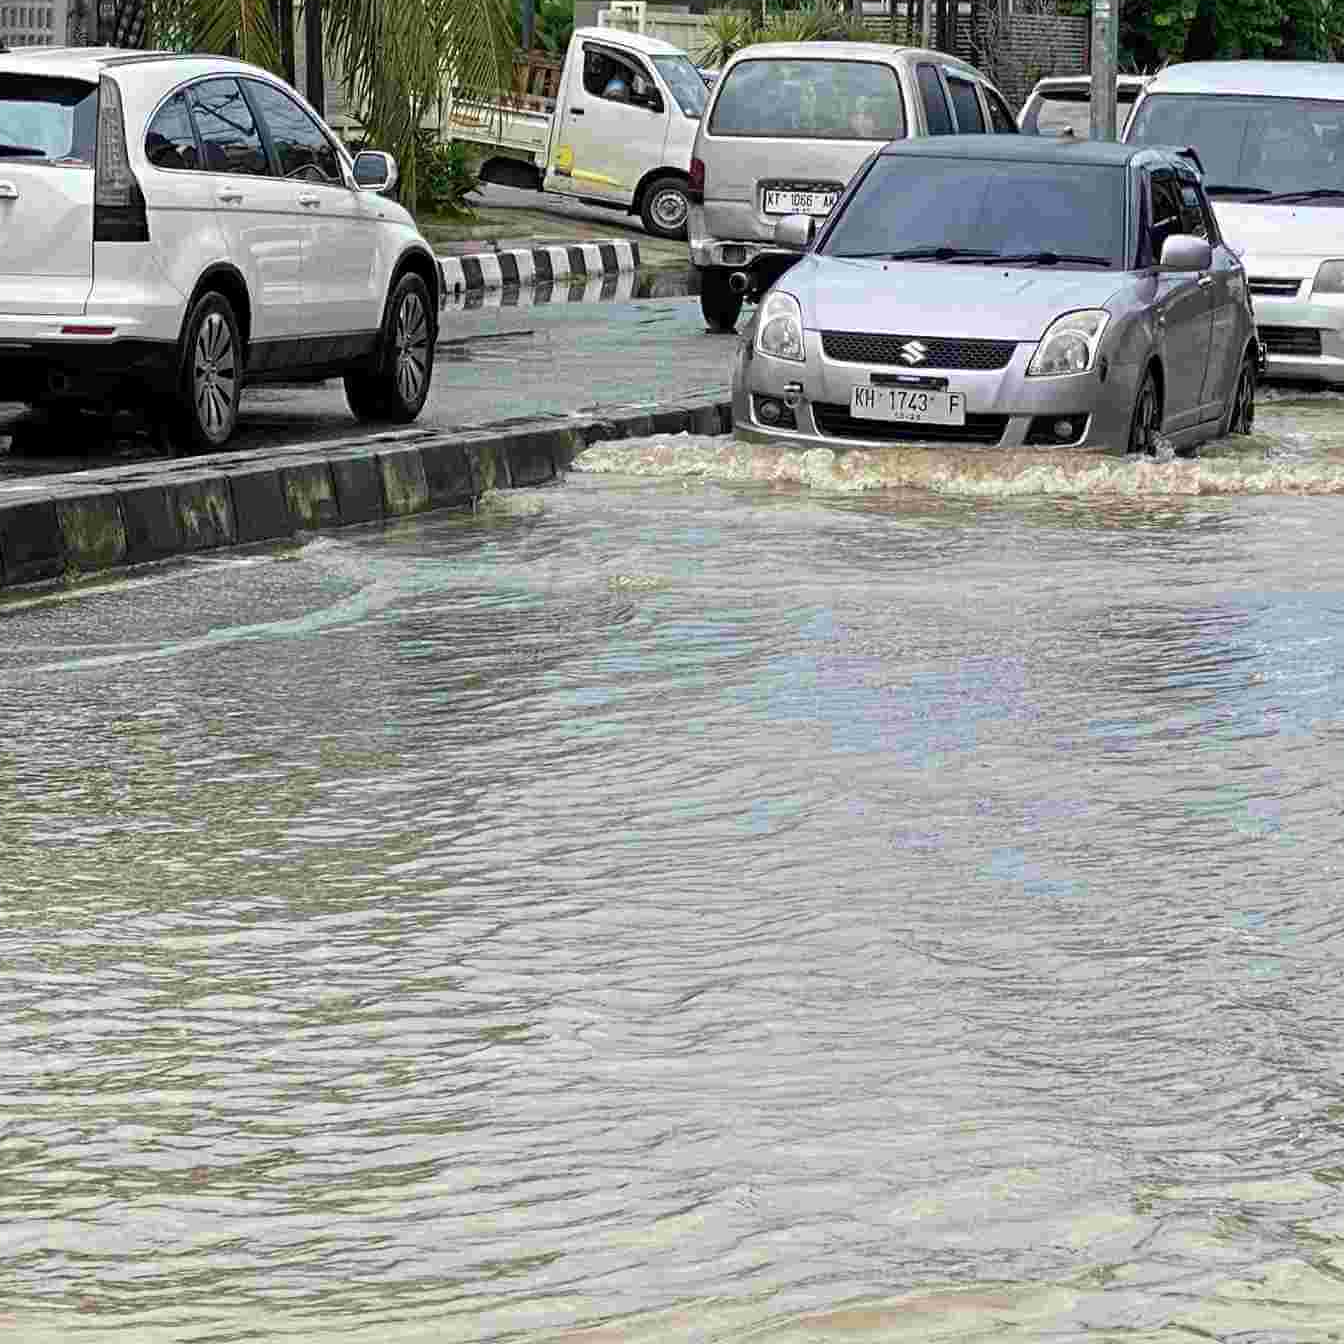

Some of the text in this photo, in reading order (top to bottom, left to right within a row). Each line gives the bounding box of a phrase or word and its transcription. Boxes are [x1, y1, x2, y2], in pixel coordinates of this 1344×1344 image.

[855, 387, 960, 416] KH 1743 F
